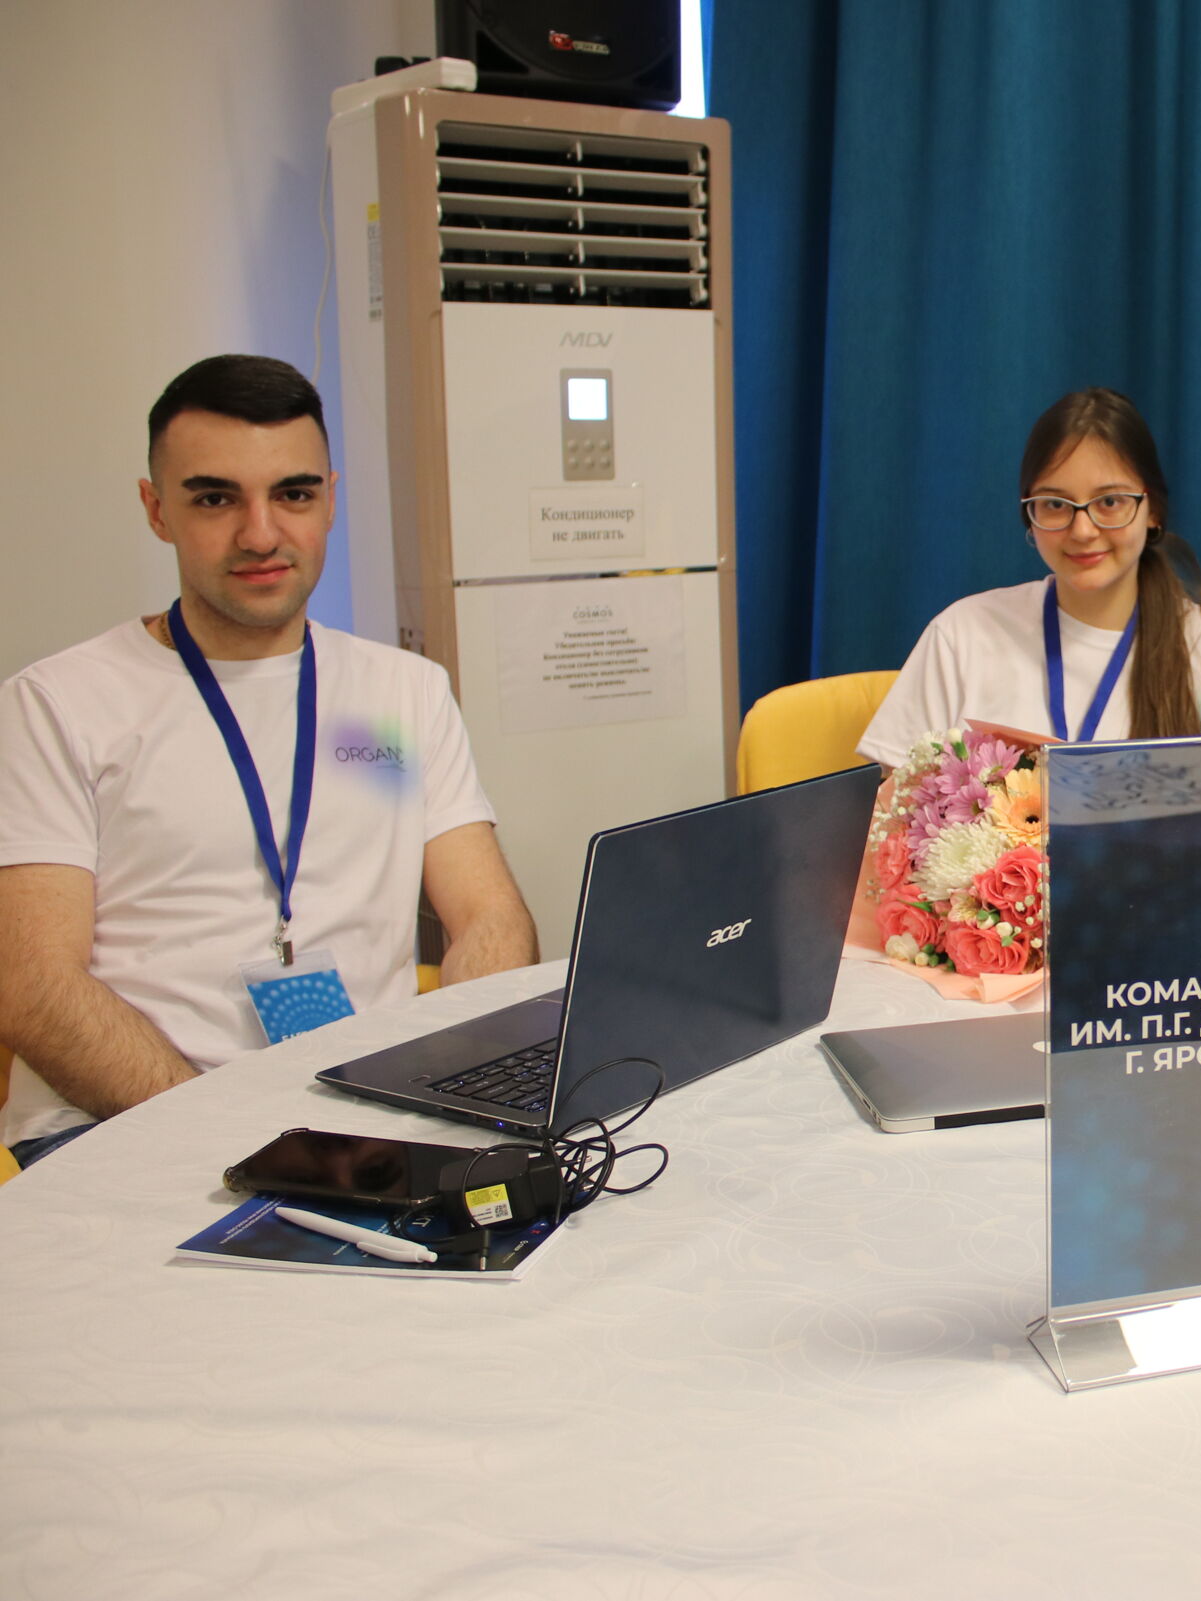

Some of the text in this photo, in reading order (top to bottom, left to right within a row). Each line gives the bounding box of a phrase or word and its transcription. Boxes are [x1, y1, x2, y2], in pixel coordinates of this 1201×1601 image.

[559, 331, 613, 348] MDV
[541, 507, 635, 523] Кондиционер
[552, 529, 625, 543] не двигать
[335, 746, 404, 764] ORGAN
[706, 918, 752, 947] acer
[1070, 1018, 1132, 1046] ИМ.
[1141, 1012, 1192, 1040] П.Г.
[1126, 1051, 1145, 1075] Г.
